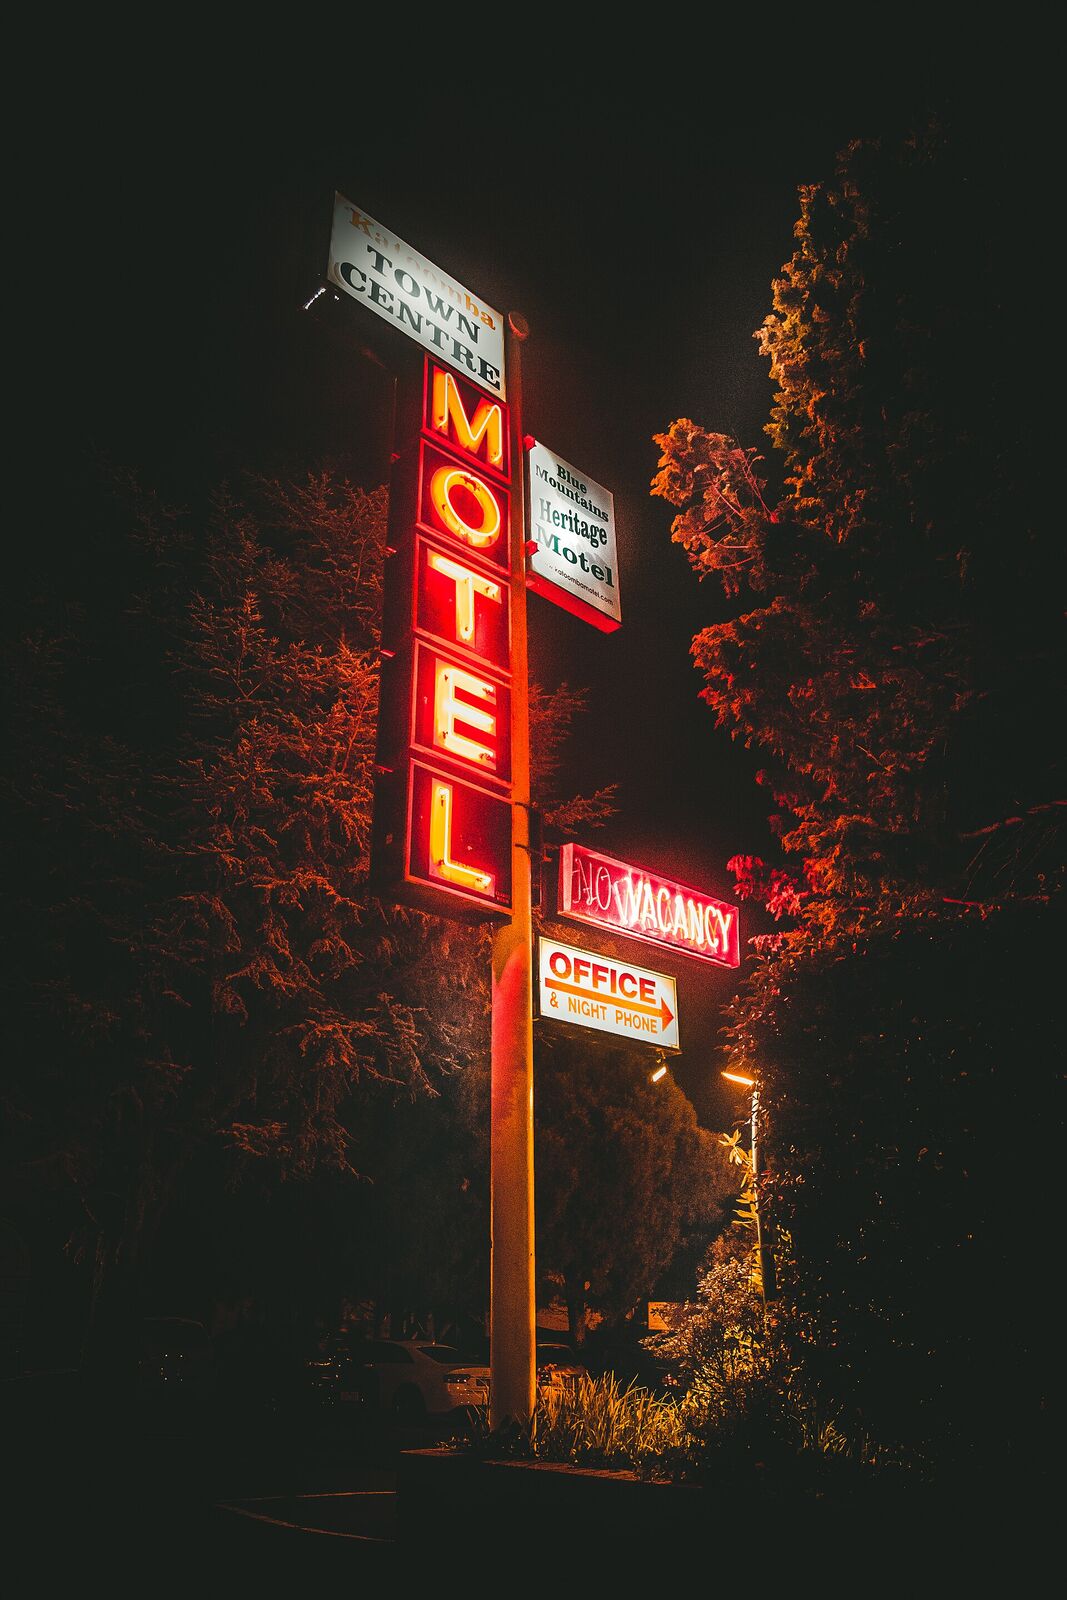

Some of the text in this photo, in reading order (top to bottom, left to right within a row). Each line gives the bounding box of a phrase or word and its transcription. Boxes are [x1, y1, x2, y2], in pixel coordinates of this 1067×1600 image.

[367, 244, 481, 344] TOWN
[339, 261, 501, 391] CENTRE
[535, 464, 609, 523] Mountains
[556, 464, 587, 494] Blue
[539, 498, 608, 548] Heritage
[536, 523, 615, 588] Motel
[428, 366, 504, 898] MOTEL
[572, 858, 731, 952] NO VACANCY
[549, 951, 657, 1005] OFFICE
[549, 991, 658, 1034] & NIGHT PHONE
